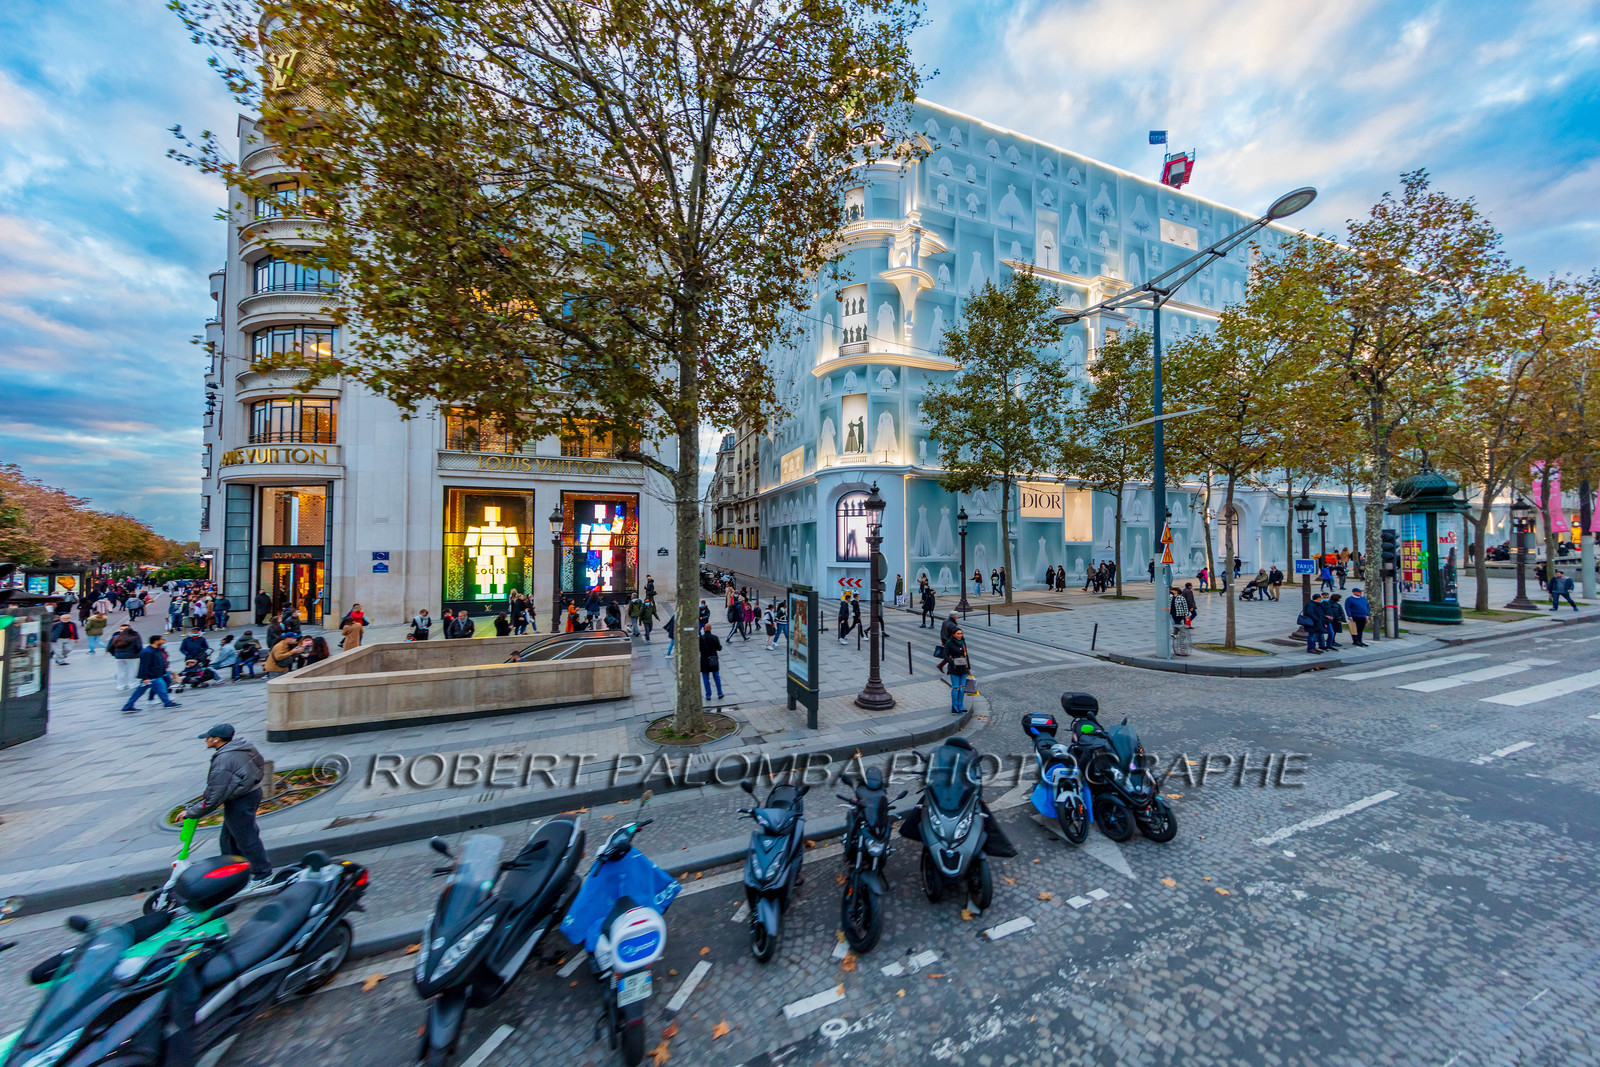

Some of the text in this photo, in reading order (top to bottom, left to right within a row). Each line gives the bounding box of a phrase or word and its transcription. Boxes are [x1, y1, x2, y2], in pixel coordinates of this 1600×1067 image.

[245, 448, 327, 464] VUITTON
[478, 455, 610, 475] LOUIS VUITTON
[1022, 493, 1062, 509] DIOR
[474, 567, 506, 575] LOUIS
